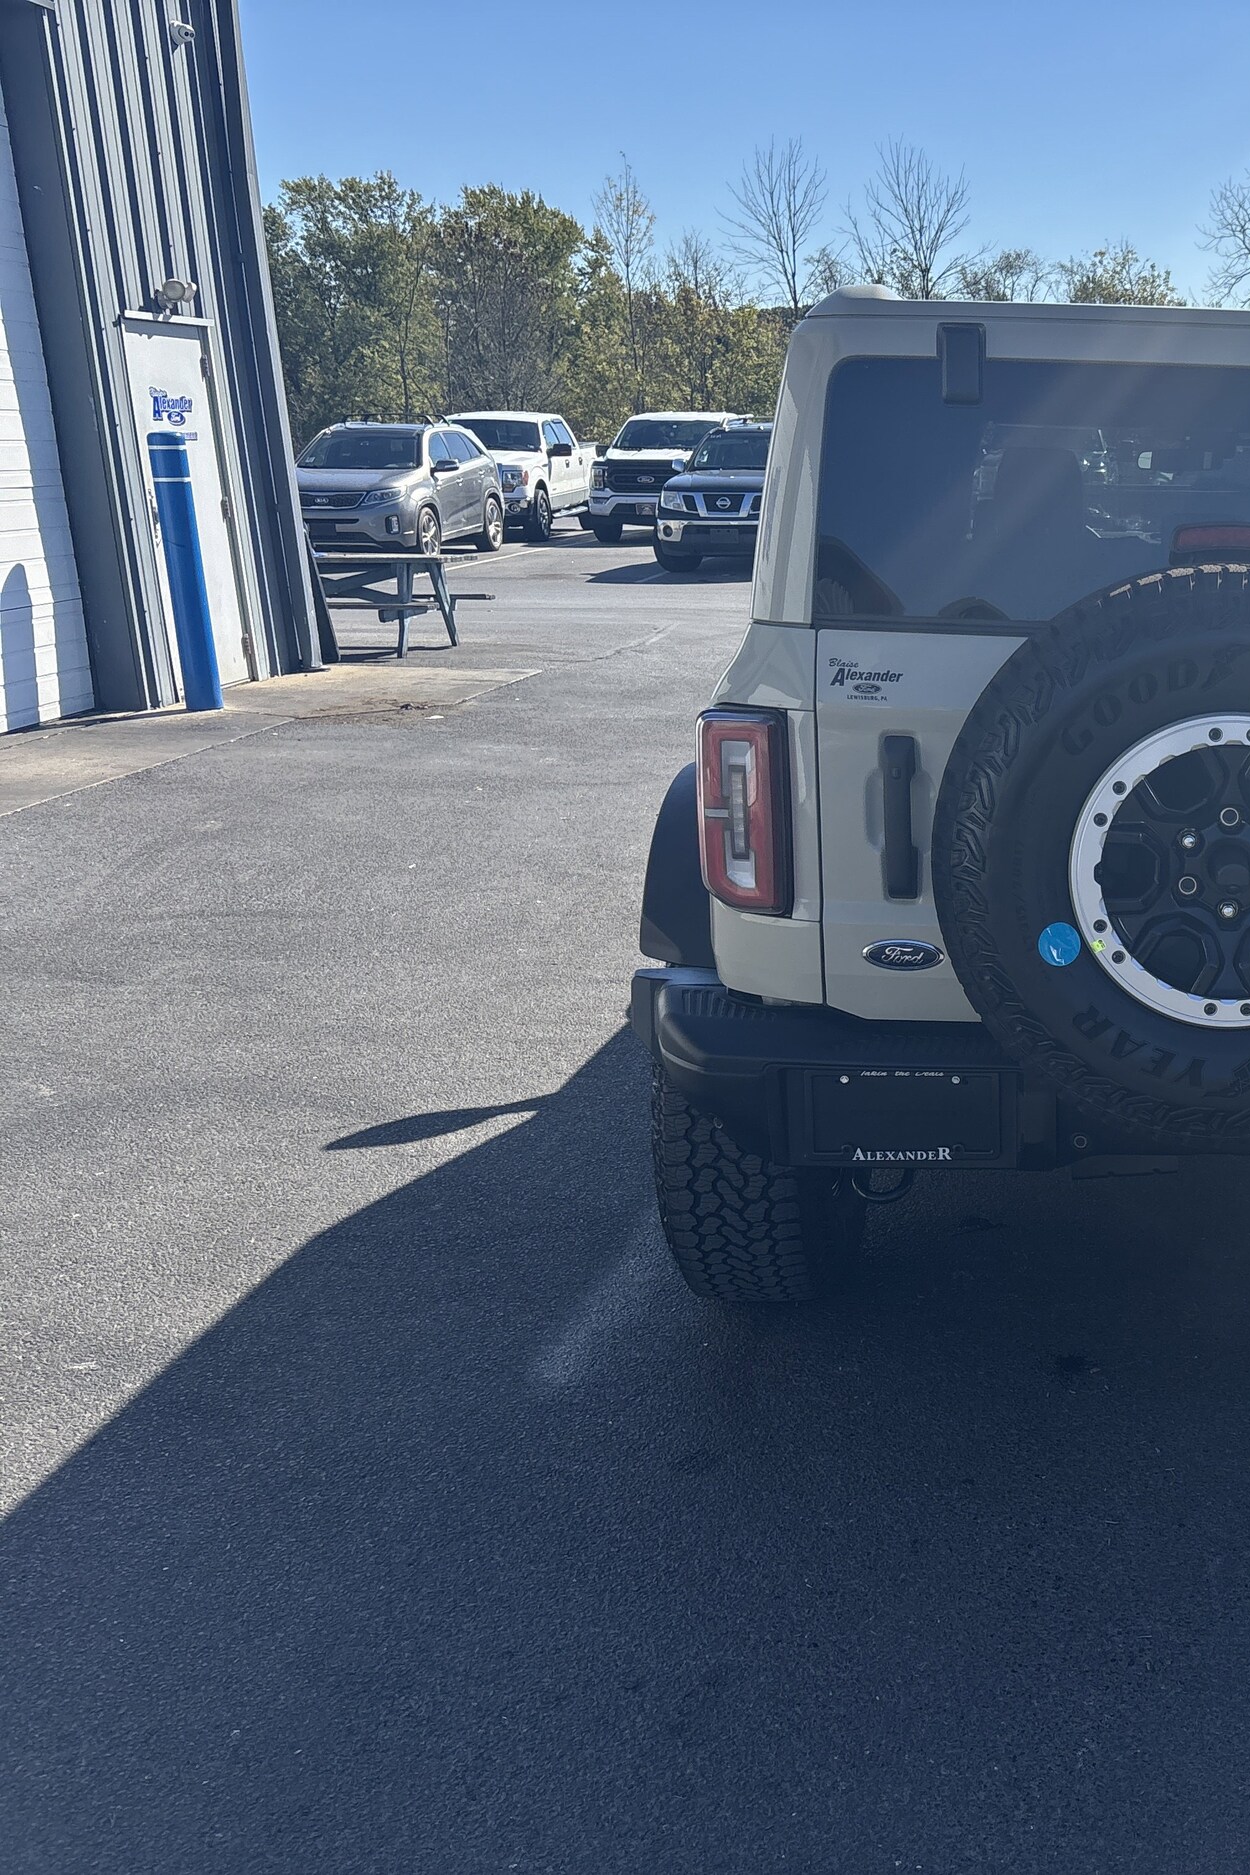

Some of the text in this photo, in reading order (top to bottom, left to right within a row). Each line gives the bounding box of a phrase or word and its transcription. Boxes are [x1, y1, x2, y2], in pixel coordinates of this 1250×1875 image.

[153, 396, 193, 421] Alexander
[829, 658, 859, 668] Blaise
[830, 667, 903, 686] Alexander
[881, 946, 925, 964] Ford
[852, 1147, 952, 1161] ALEXANDER
